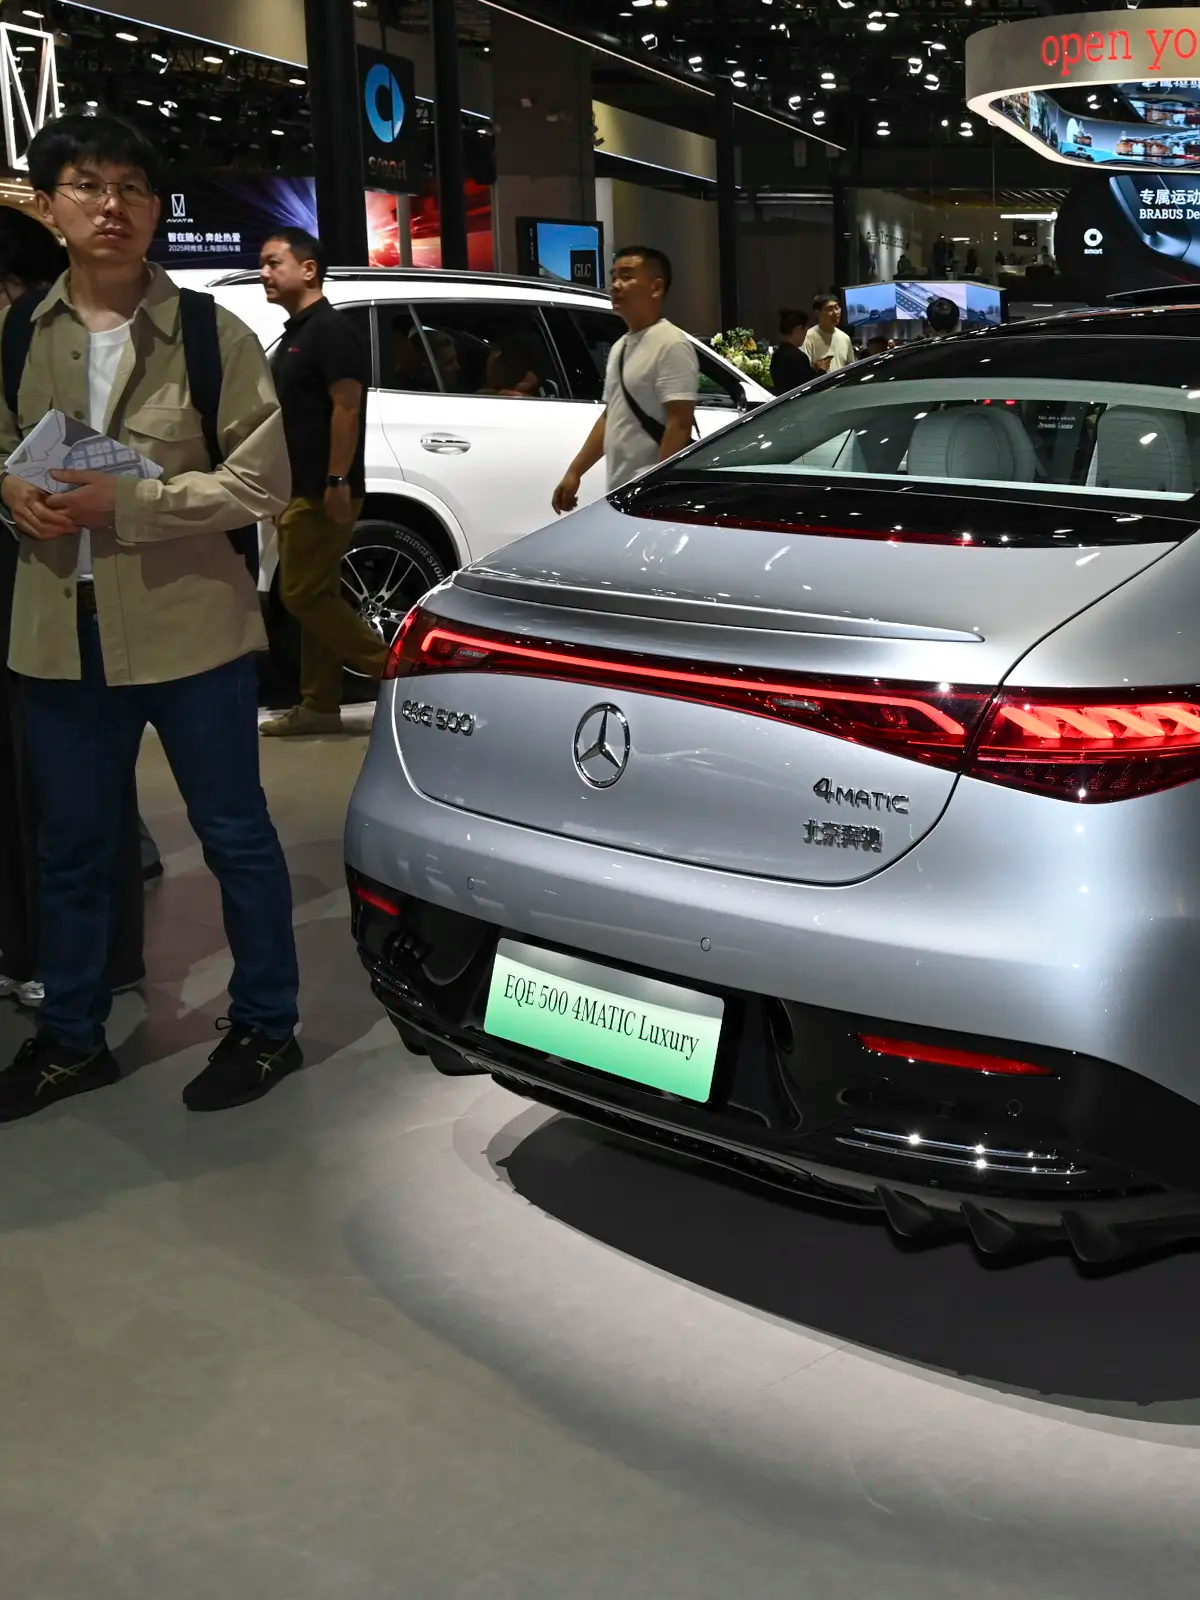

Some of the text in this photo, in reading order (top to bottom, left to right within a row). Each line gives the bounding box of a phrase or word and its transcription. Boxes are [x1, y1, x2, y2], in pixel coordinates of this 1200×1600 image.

[1042, 29, 1133, 76] open
[1139, 208, 1184, 220] BRABUS
[1083, 247, 1103, 255] smart
[573, 263, 592, 278] GLC
[436, 707, 475, 737] 500
[813, 777, 910, 815] 4MATIC
[503, 973, 701, 1061] EQE 500 4MATIC Luxury
